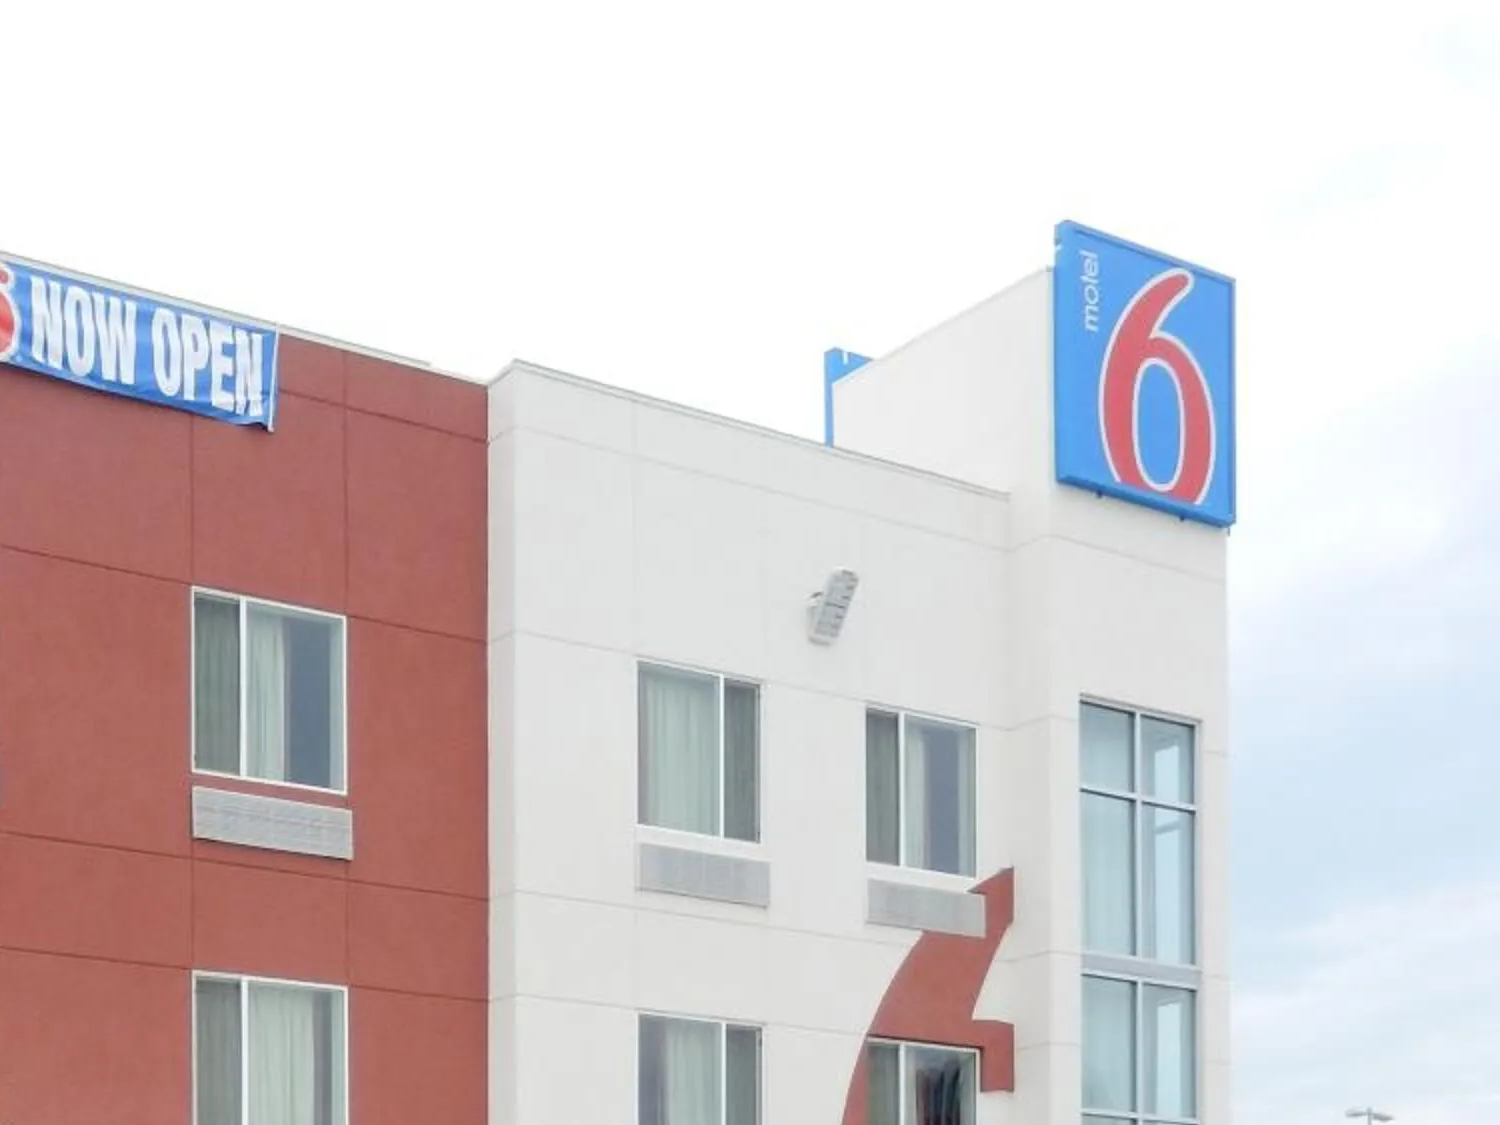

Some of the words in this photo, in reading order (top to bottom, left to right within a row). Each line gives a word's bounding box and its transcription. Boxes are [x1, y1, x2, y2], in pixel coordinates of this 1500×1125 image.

[30, 275, 138, 385] NOW
[152, 307, 263, 417] OPEN
[1079, 250, 1099, 332] motel
[1100, 268, 1215, 504] 6
